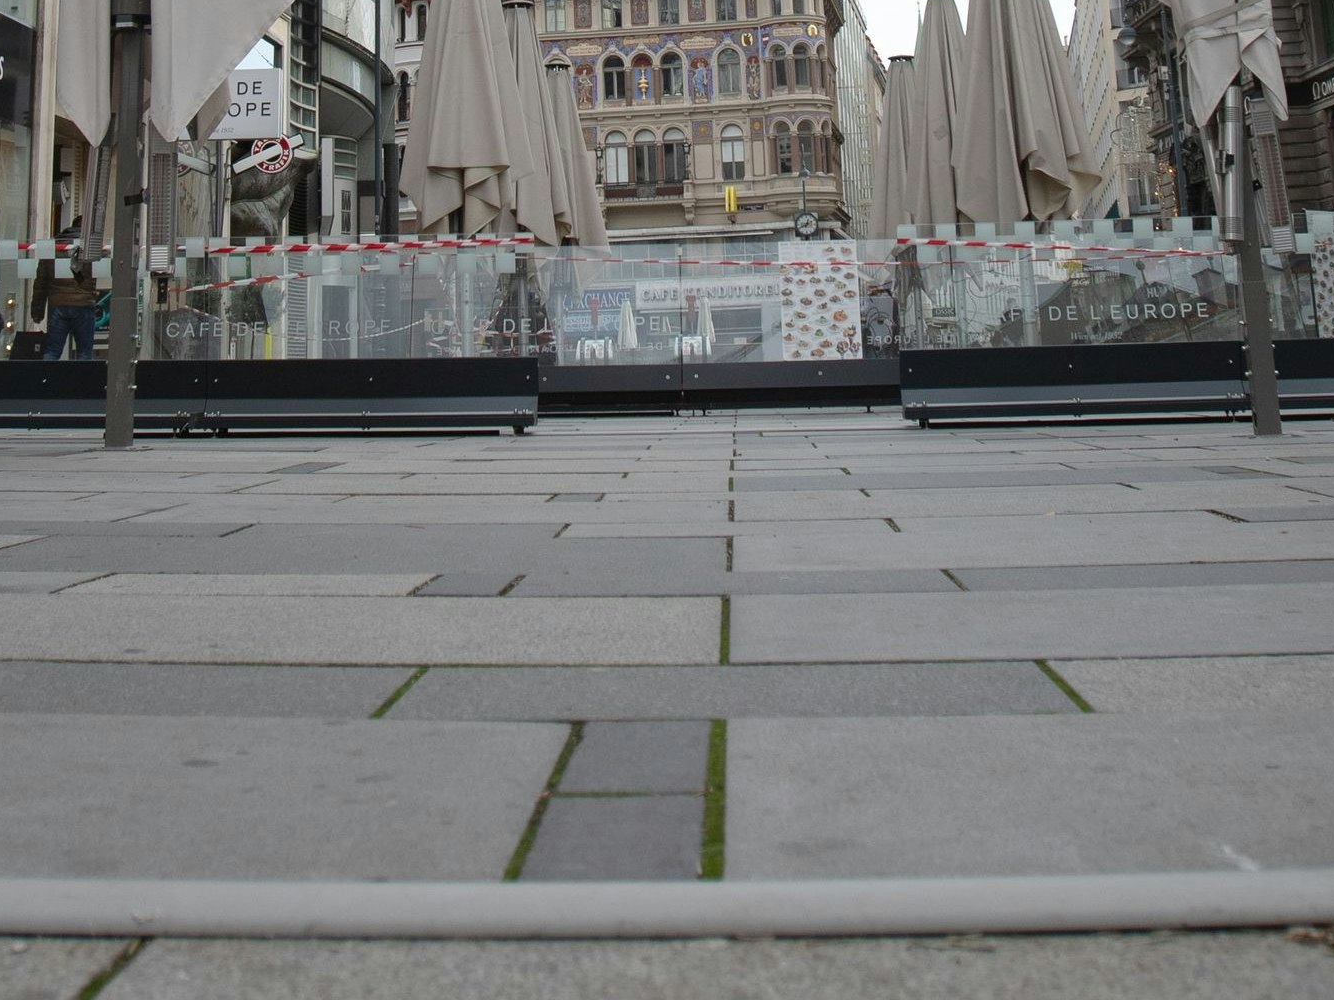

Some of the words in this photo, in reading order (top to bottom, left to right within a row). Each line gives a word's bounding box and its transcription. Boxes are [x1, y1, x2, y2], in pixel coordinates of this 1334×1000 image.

[237, 81, 263, 96] DE
[227, 102, 271, 117] OPE
[261, 148, 291, 172] TRAFIK
[1049, 305, 1078, 321] DE
[1091, 302, 1209, 321] L'EUROPE
[503, 318, 532, 333] DE
